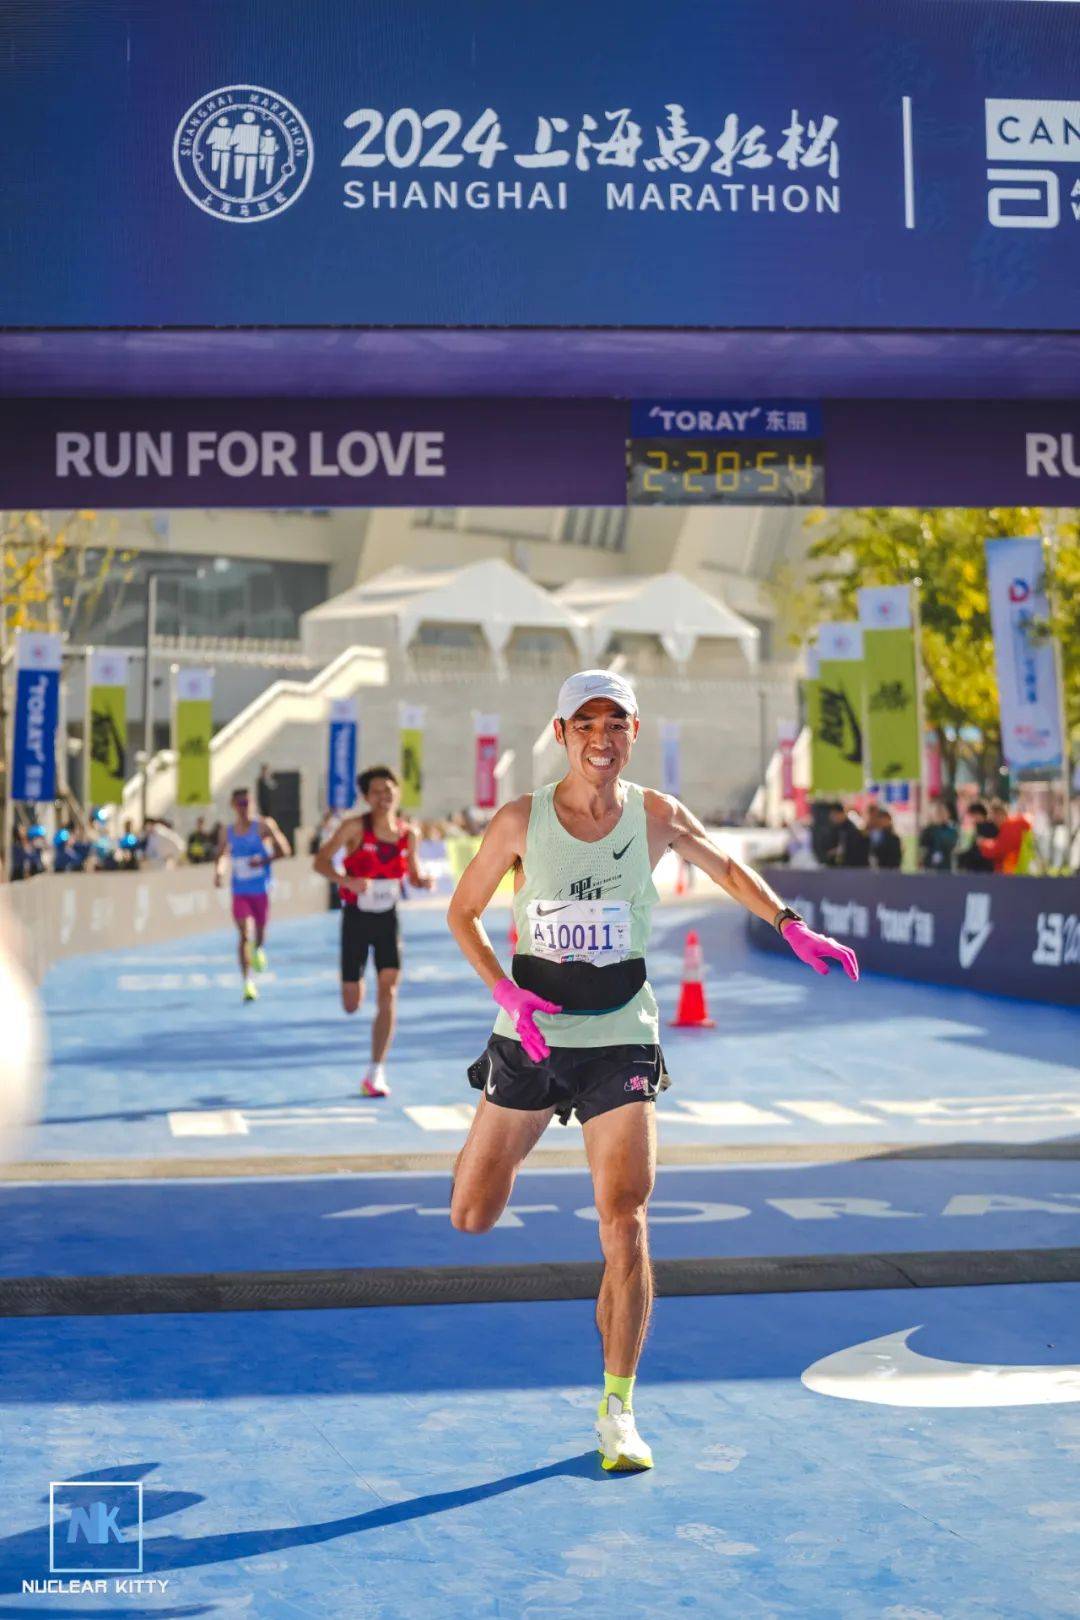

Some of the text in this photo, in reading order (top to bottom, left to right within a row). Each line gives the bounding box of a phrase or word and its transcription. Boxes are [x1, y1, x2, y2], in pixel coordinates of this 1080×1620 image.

[340, 107, 509, 169] 2024
[343, 180, 840, 213] SHANGHAI MARATHON
[56, 431, 446, 477] RUN FOR LOVE
[643, 451, 814, 493] 2:28:54
